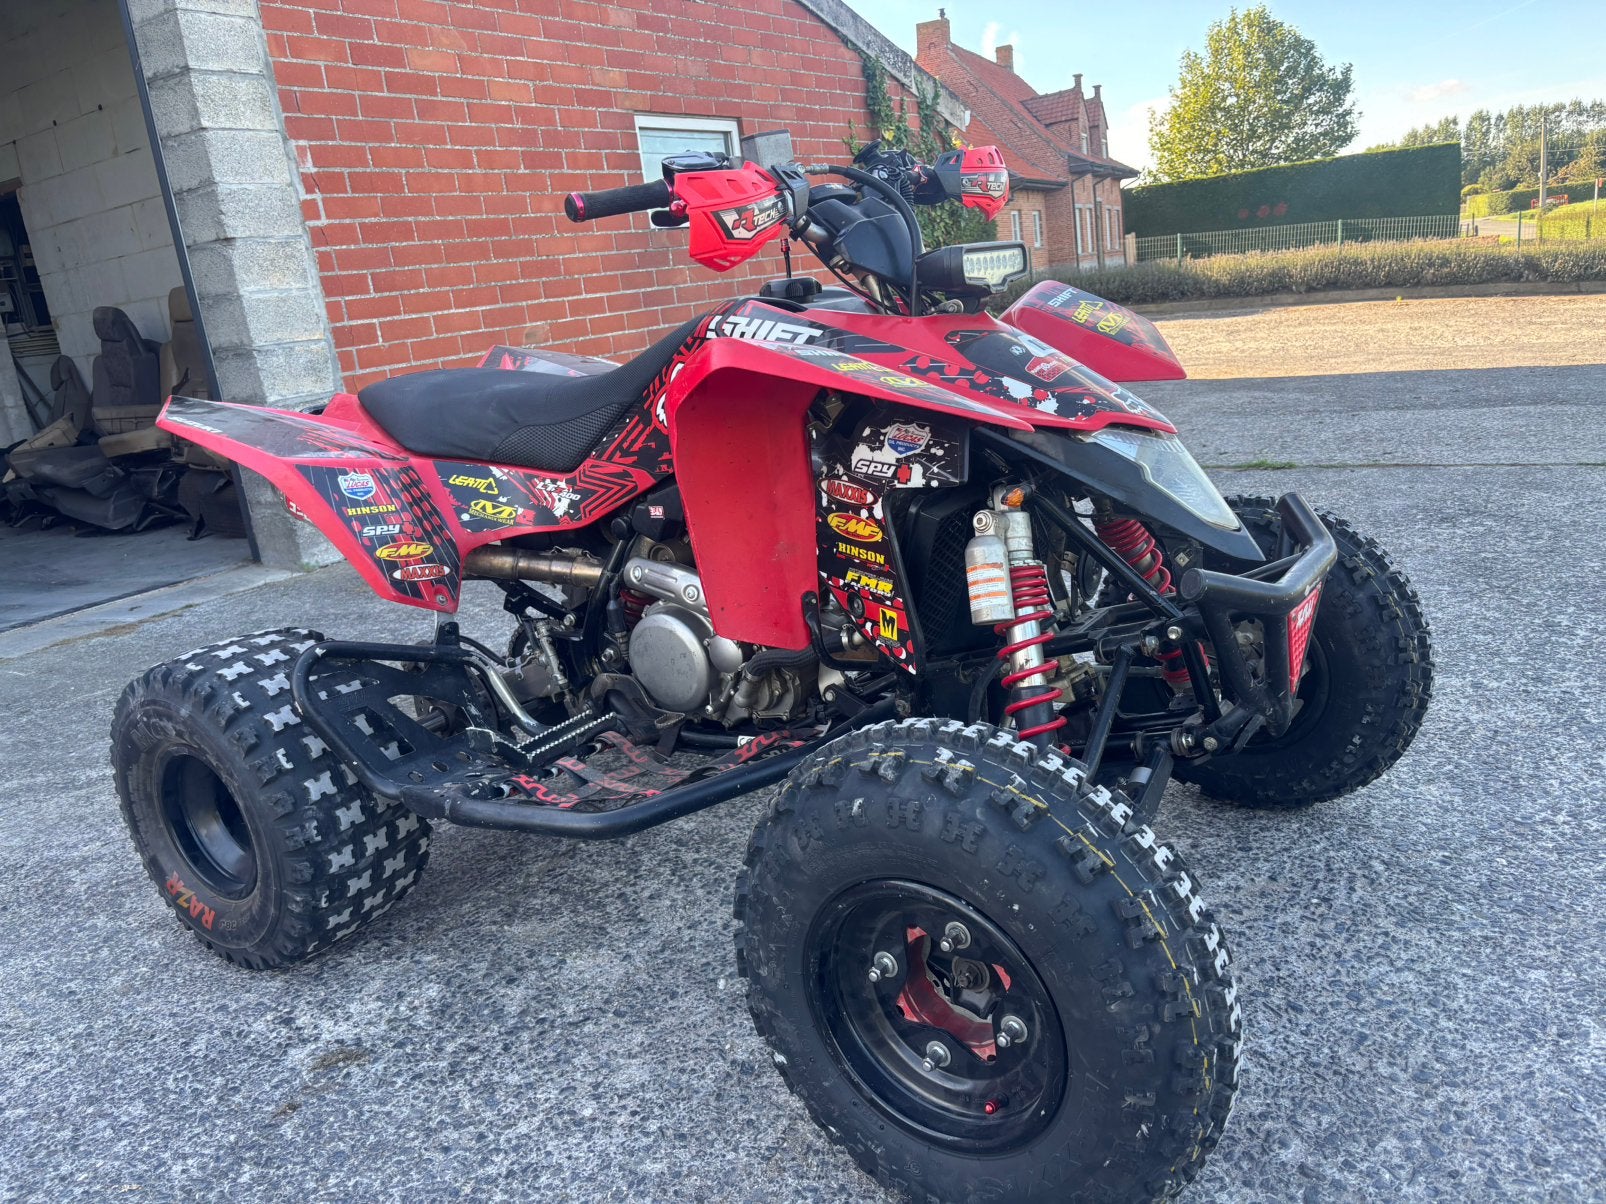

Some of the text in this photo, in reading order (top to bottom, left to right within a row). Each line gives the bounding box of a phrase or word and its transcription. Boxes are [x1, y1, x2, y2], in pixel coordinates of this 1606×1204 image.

[1047, 287, 1077, 308] SHIFT
[854, 459, 897, 478] SPY
[826, 480, 868, 504] MAXXIS
[347, 504, 397, 516] HINSON
[362, 524, 401, 537] SPY
[829, 516, 881, 537] FMF
[380, 543, 430, 558] FMF
[838, 542, 886, 565] HINSON
[401, 565, 446, 580] MAXXIS
[846, 570, 893, 594] FMR
